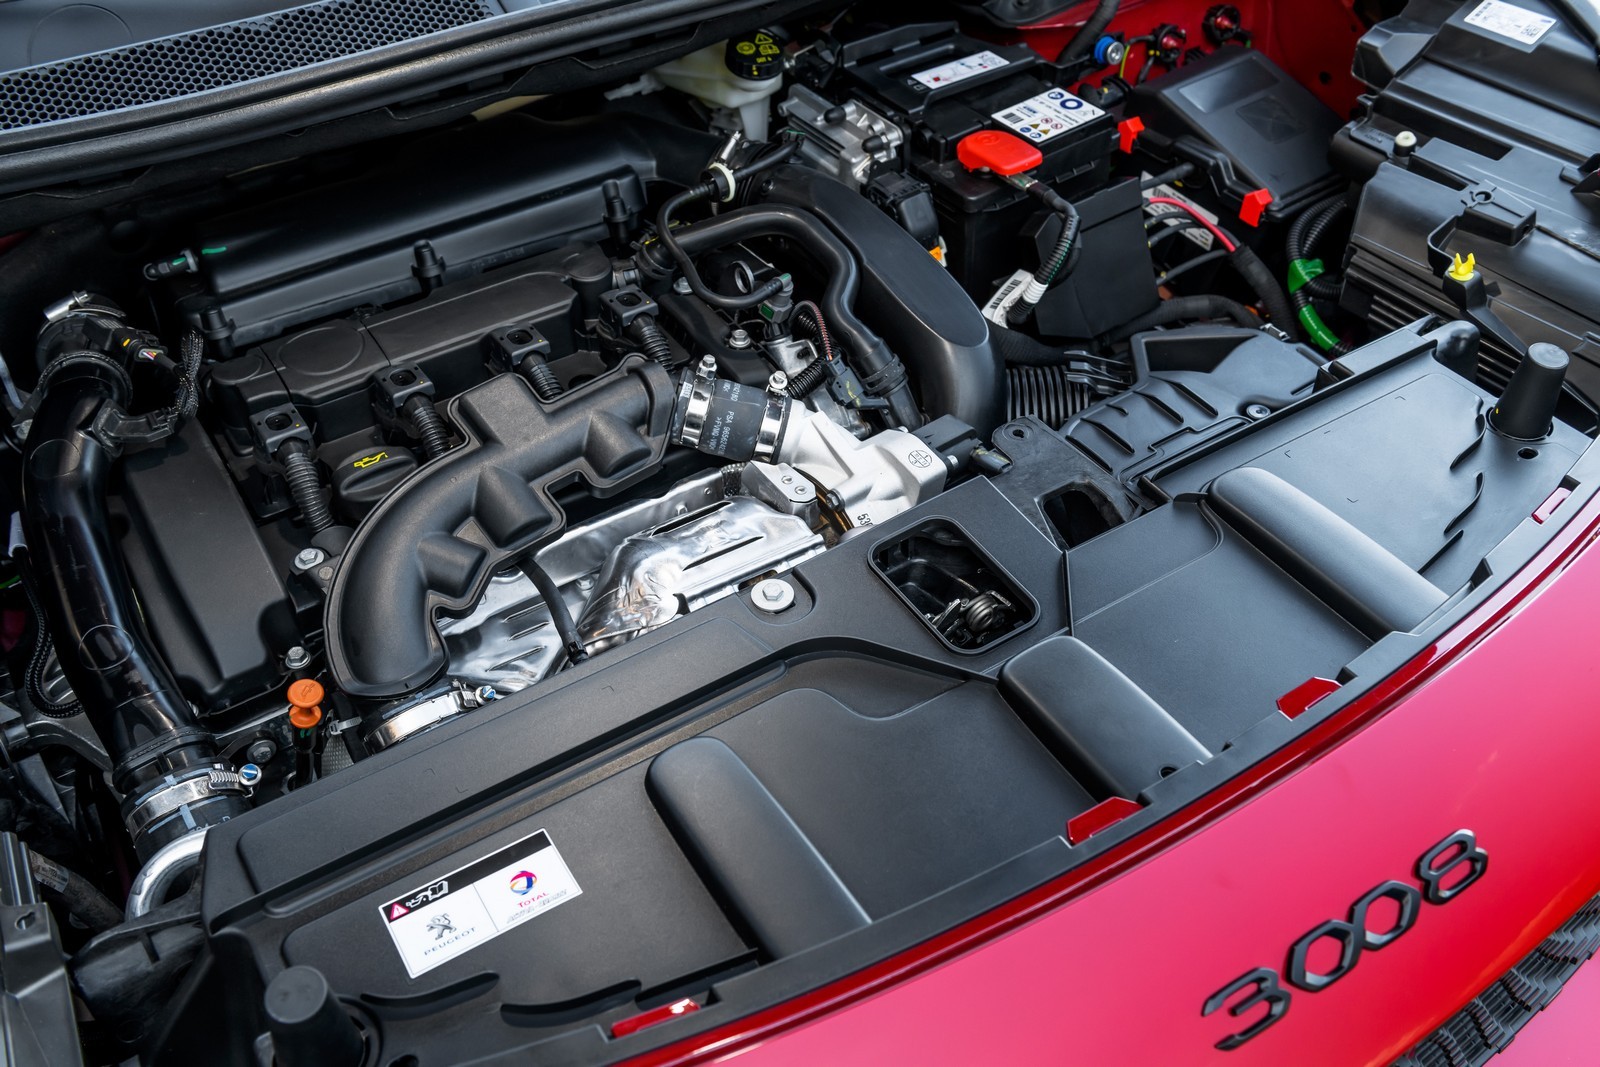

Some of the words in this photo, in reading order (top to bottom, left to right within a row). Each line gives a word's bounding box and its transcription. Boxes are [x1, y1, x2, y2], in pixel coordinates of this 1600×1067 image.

[725, 410, 735, 424] PSA
[424, 927, 476, 956] PEUGEOT
[1201, 828, 1488, 1051] 3008
